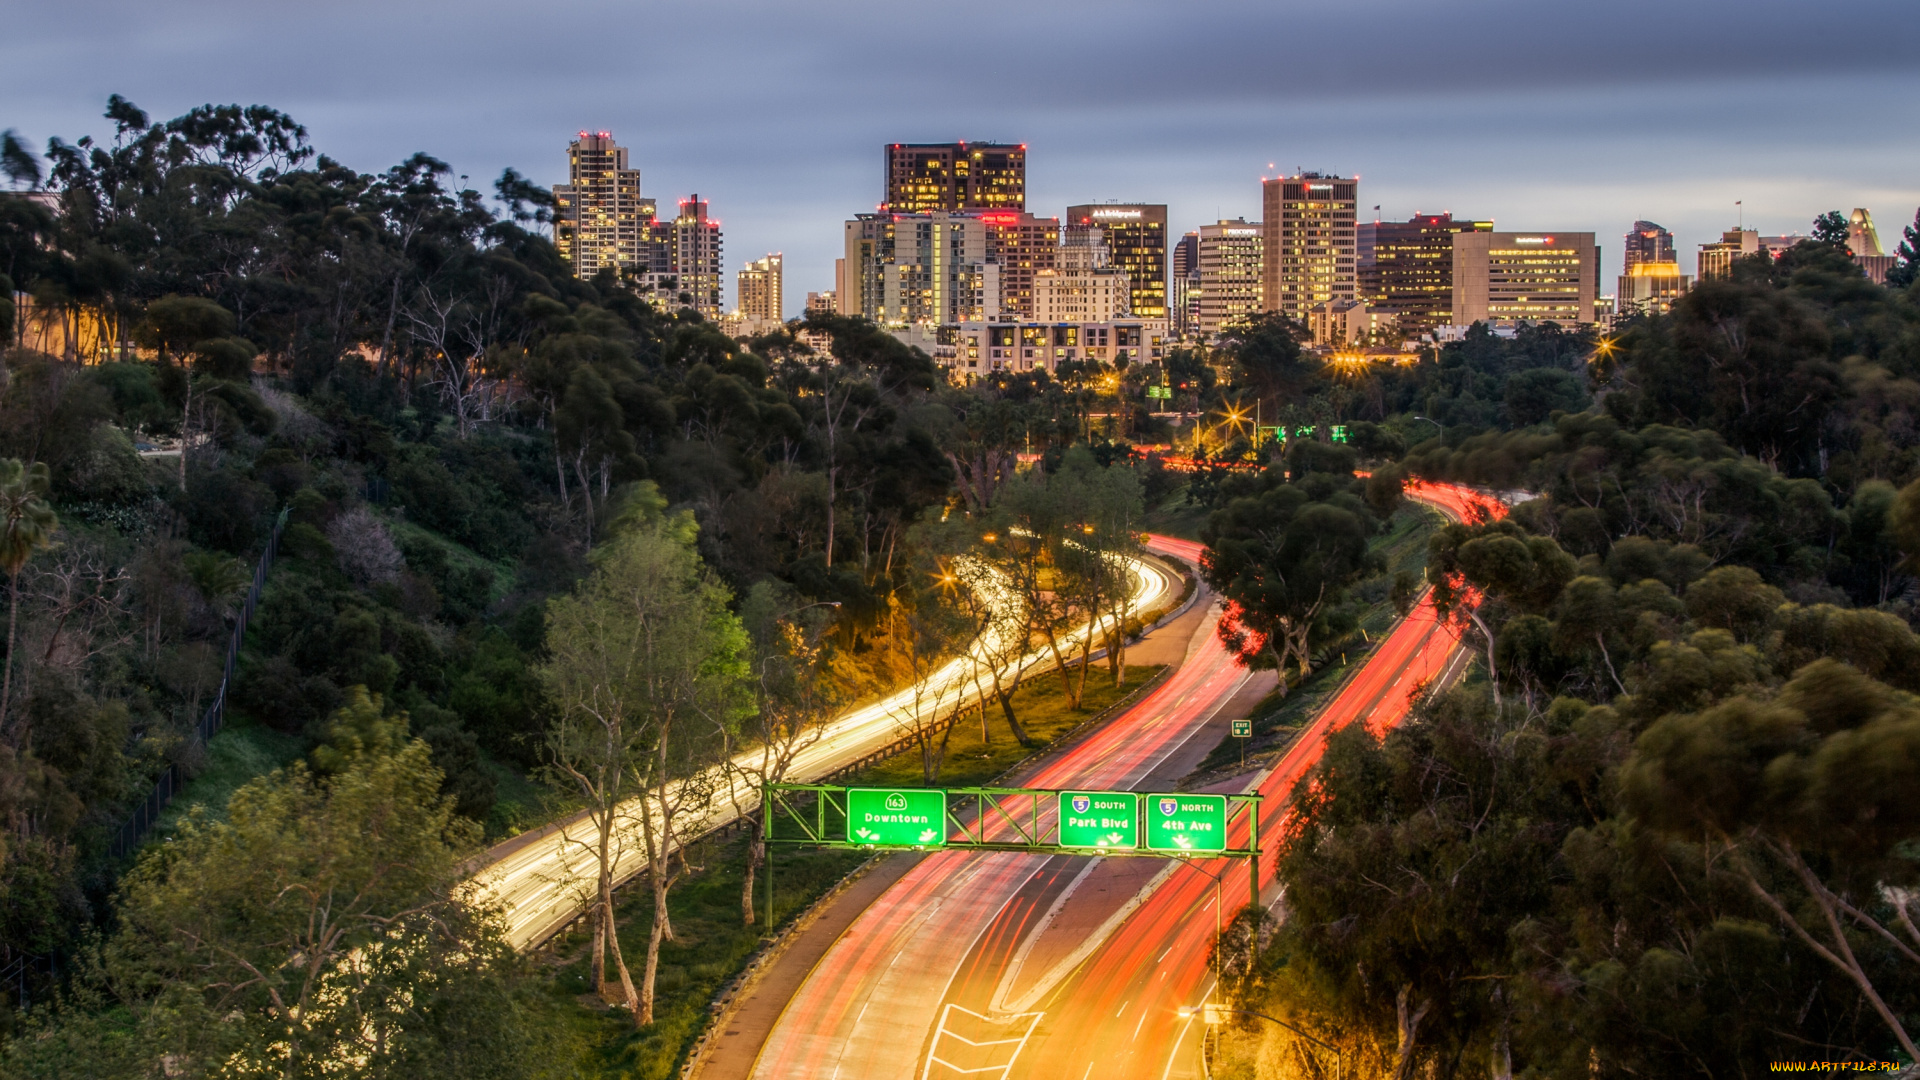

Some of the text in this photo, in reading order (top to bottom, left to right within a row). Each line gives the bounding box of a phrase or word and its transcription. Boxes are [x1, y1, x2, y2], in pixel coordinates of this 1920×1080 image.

[889, 799, 904, 807] 163
[1078, 801, 1126, 809] 5 SOUTH
[1165, 804, 1213, 812] 5 NORTH
[865, 813, 928, 823] Downtown
[1069, 817, 1128, 828] Park Blvd
[1162, 820, 1212, 831] 4th Ave
